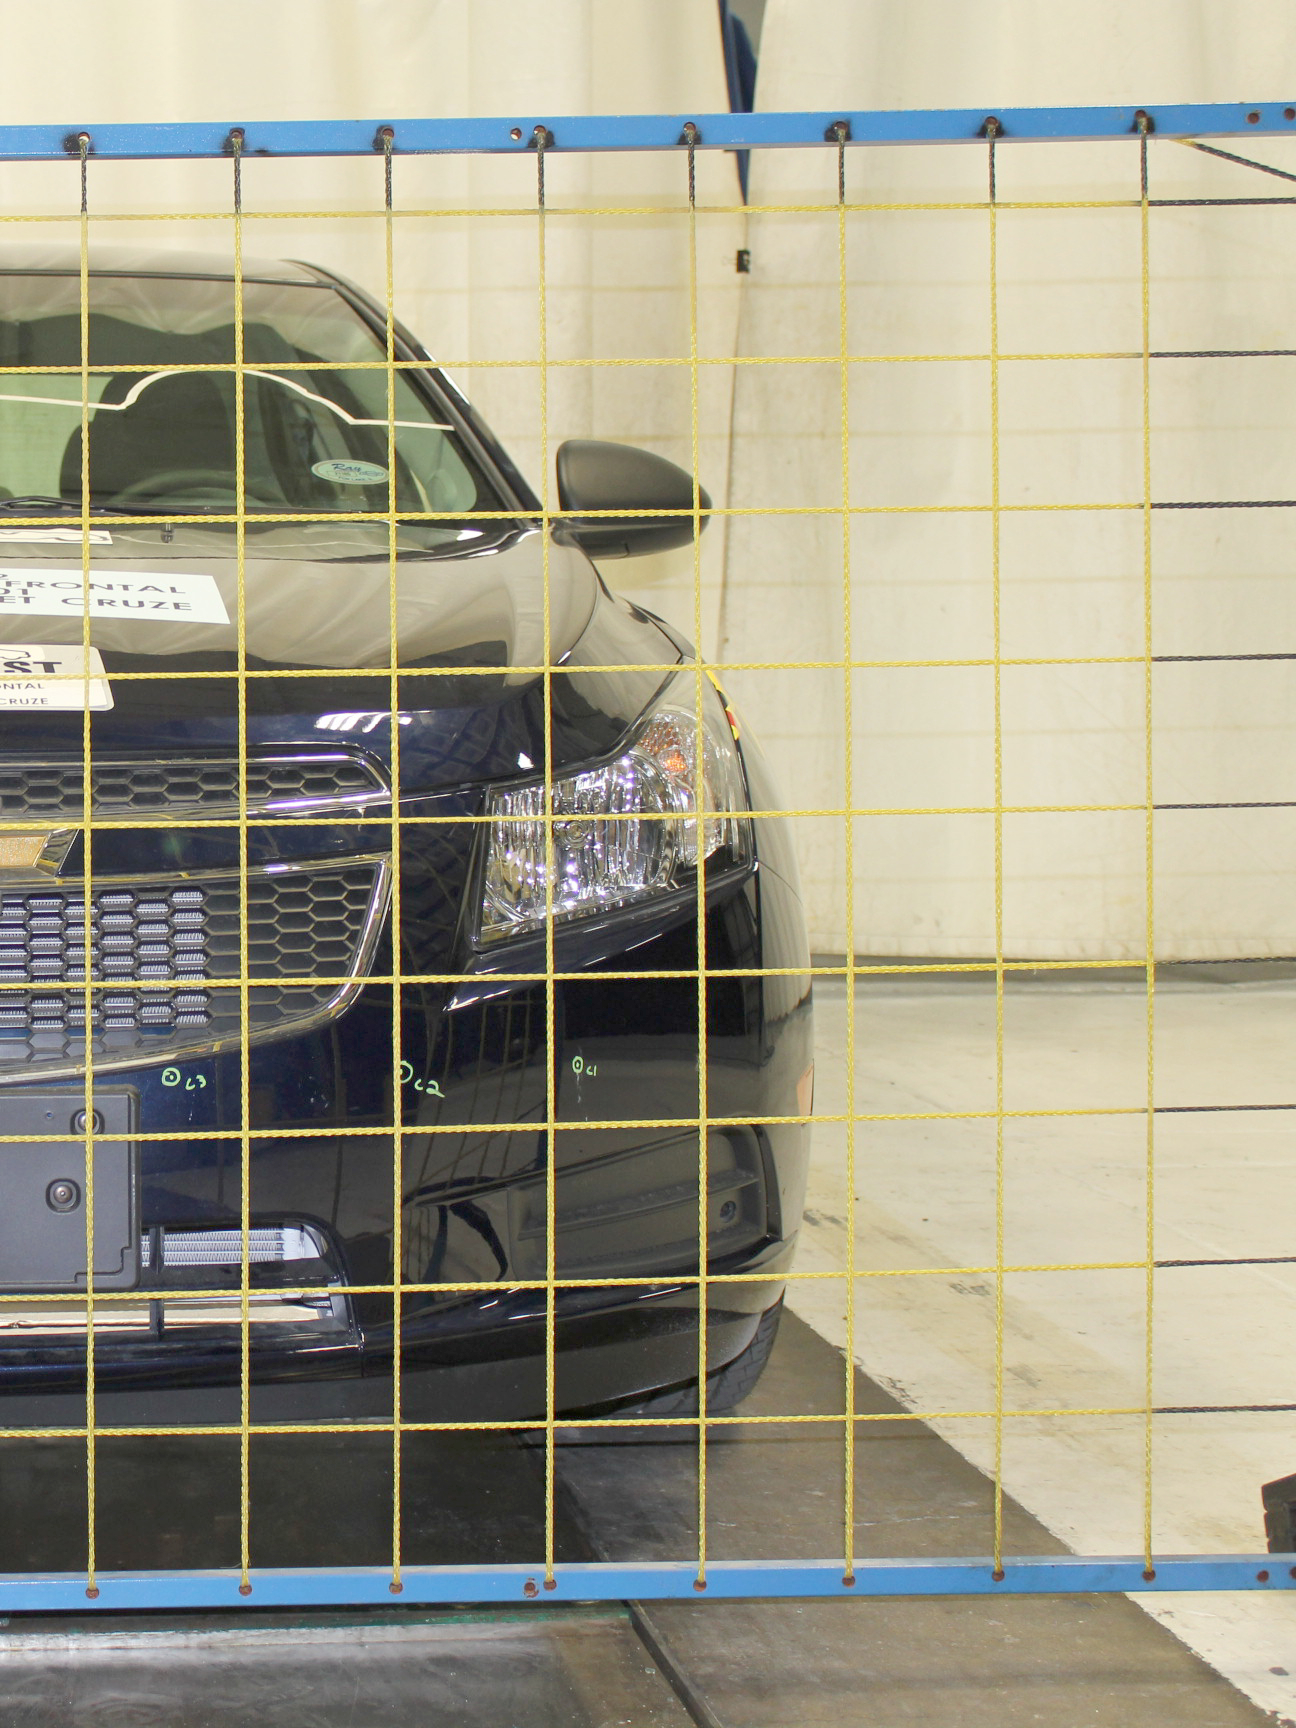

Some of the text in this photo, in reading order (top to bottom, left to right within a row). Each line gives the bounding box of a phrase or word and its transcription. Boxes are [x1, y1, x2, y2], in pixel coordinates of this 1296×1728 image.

[331, 463, 362, 473] Ray
[6, 580, 186, 594] FRONTAL
[61, 597, 193, 611] CRUZE
